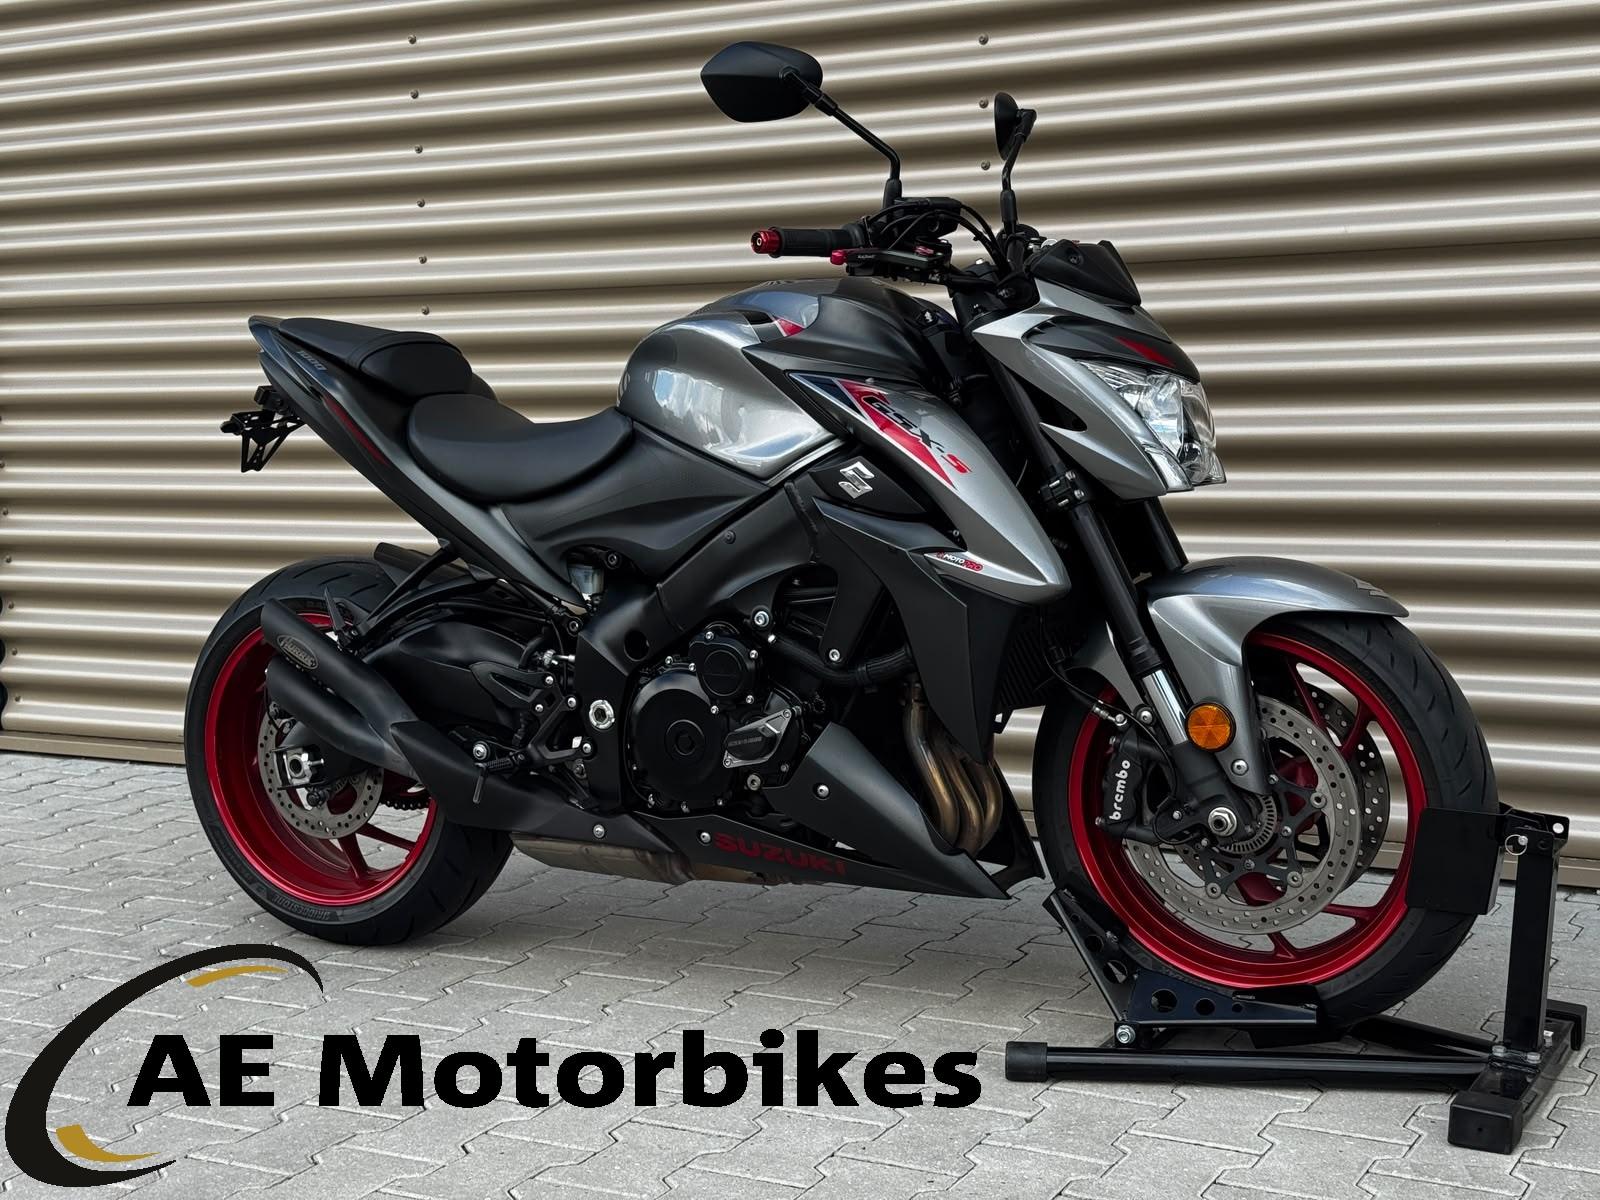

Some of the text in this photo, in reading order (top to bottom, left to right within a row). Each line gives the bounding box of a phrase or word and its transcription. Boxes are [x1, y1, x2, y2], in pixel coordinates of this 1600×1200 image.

[860, 395, 973, 474] GSX-S
[1108, 759, 1131, 821] brembo
[713, 831, 848, 878] SUZUKI
